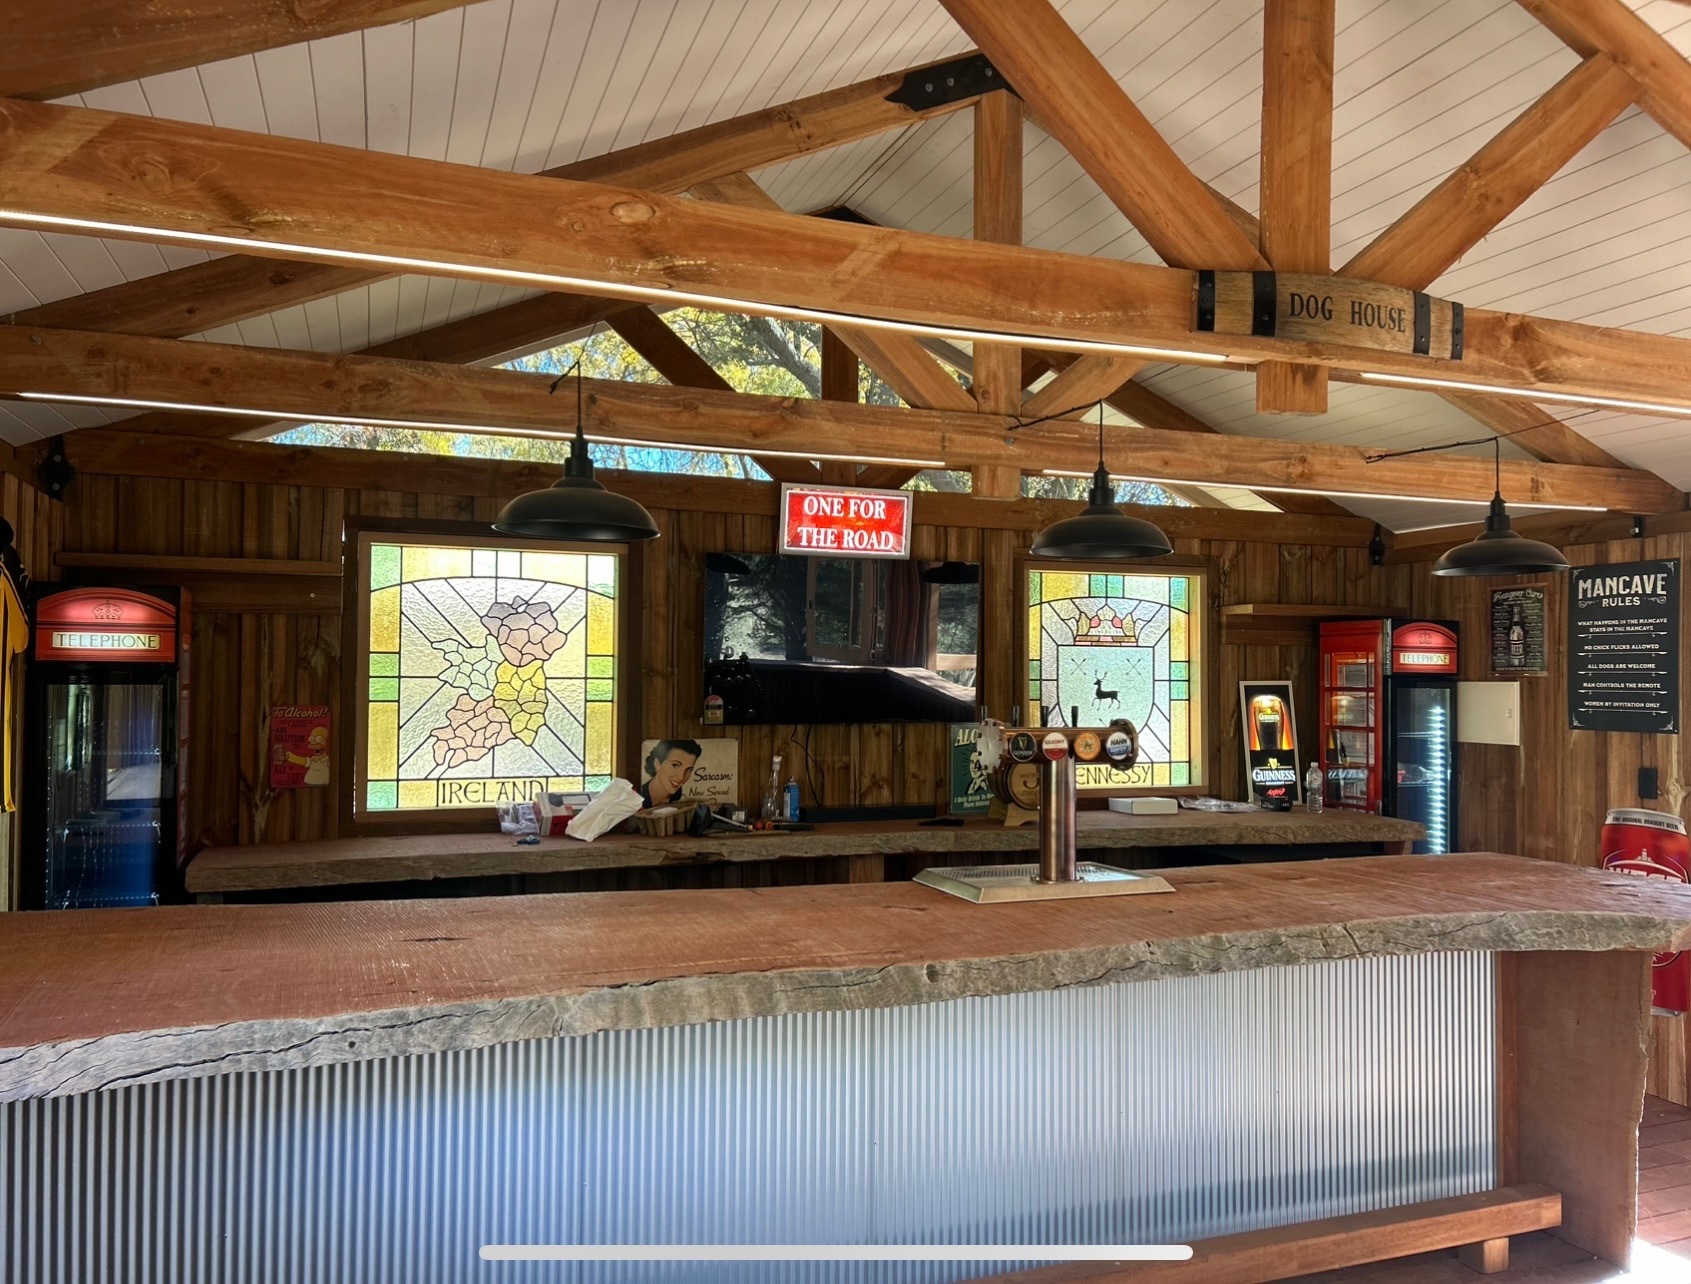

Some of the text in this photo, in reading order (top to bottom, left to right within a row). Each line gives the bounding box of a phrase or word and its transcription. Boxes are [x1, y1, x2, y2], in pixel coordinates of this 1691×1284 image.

[1289, 292, 1406, 333] DOG HOUSE
[803, 495, 886, 519] ONE FOR
[797, 526, 894, 550] THE ROAD
[1578, 573, 1667, 600] MANCAVE
[1602, 597, 1641, 607] RULES
[56, 633, 157, 649] TELEPHONE
[1402, 653, 1448, 664] TELEPHONE
[273, 706, 328, 718] To Alcohol!
[954, 728, 978, 747] ALC
[1110, 738, 1128, 747] HAHN
[693, 767, 733, 782] Sarcasm:
[1075, 766, 1151, 785] ENNESSY
[1252, 768, 1296, 782] GUINNESS
[441, 780, 545, 804] IRELAND
[688, 786, 730, 797] Now Served
[1643, 818, 1665, 827] DRAUGHT
[1666, 822, 1679, 831] BEER
